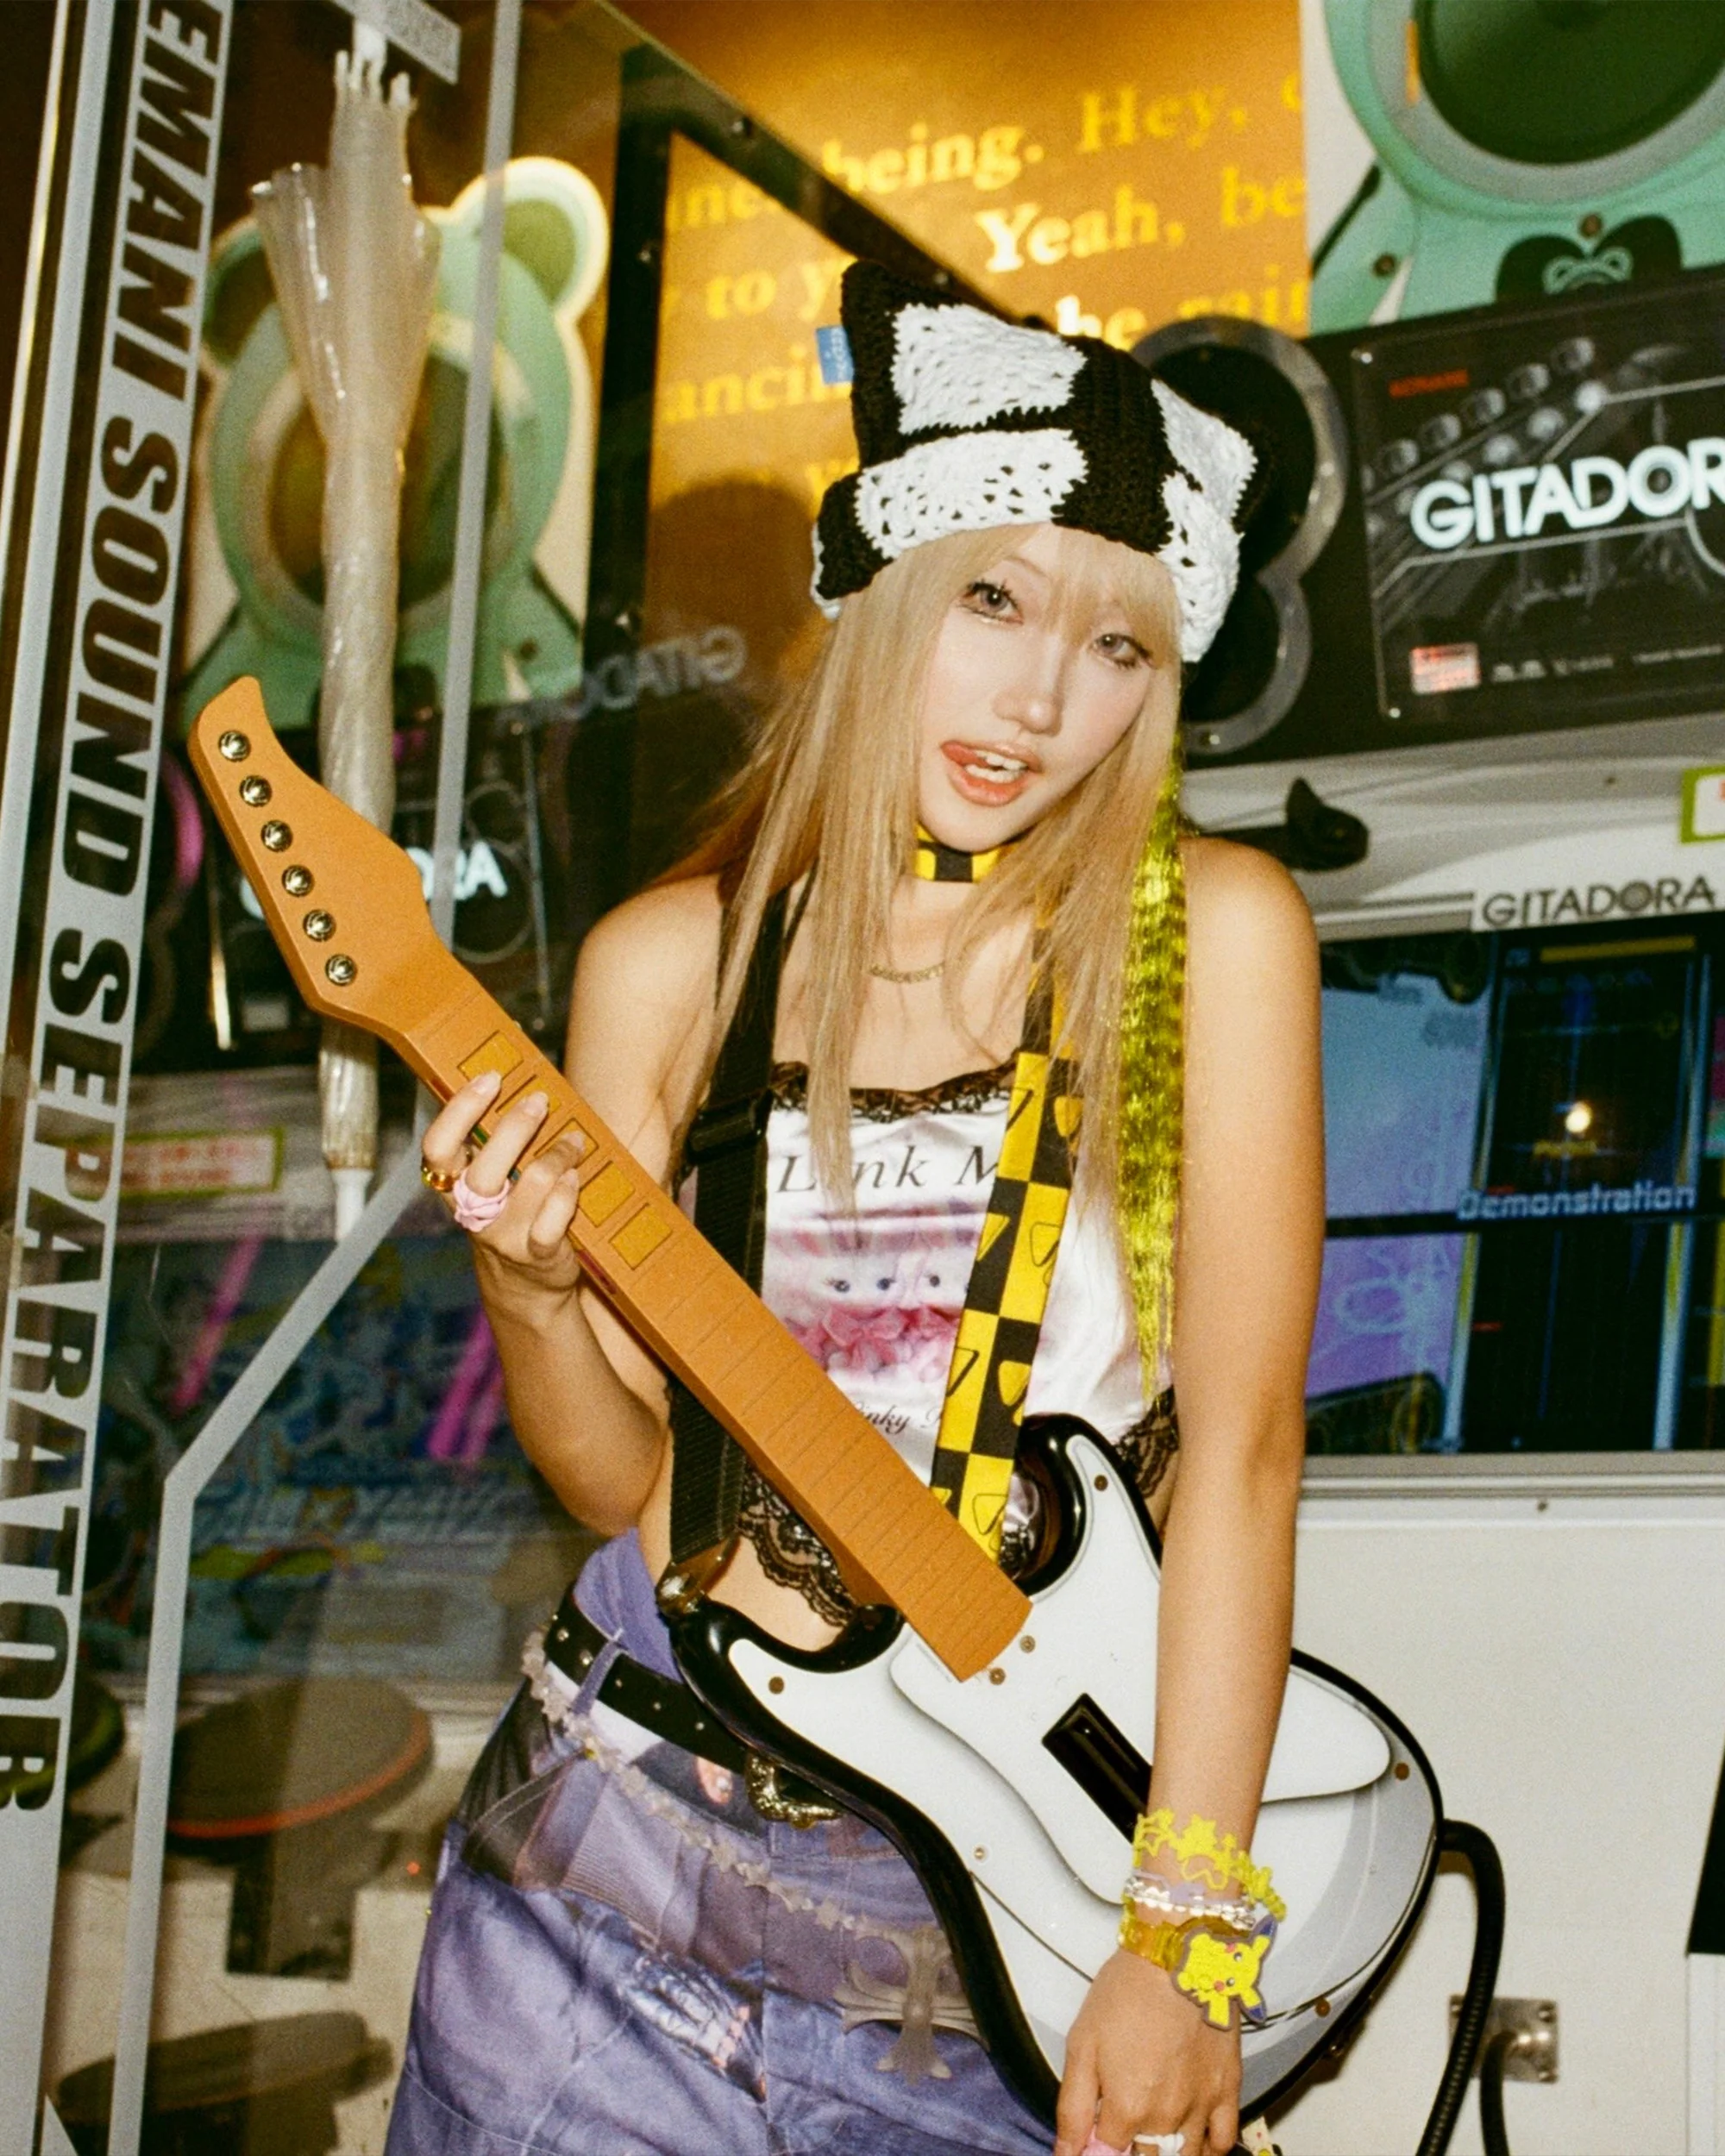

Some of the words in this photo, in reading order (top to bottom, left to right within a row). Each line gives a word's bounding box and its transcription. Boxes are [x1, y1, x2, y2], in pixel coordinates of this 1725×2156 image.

[1409, 437, 1725, 552] GITADOR
[63, 416, 178, 896] SOUND
[1482, 874, 1715, 928] GITADORA
[775, 1144, 930, 1194] Lnk
[1457, 1178, 1697, 1221] Demonstration
[0, 928, 131, 1811] SEPARATOR
